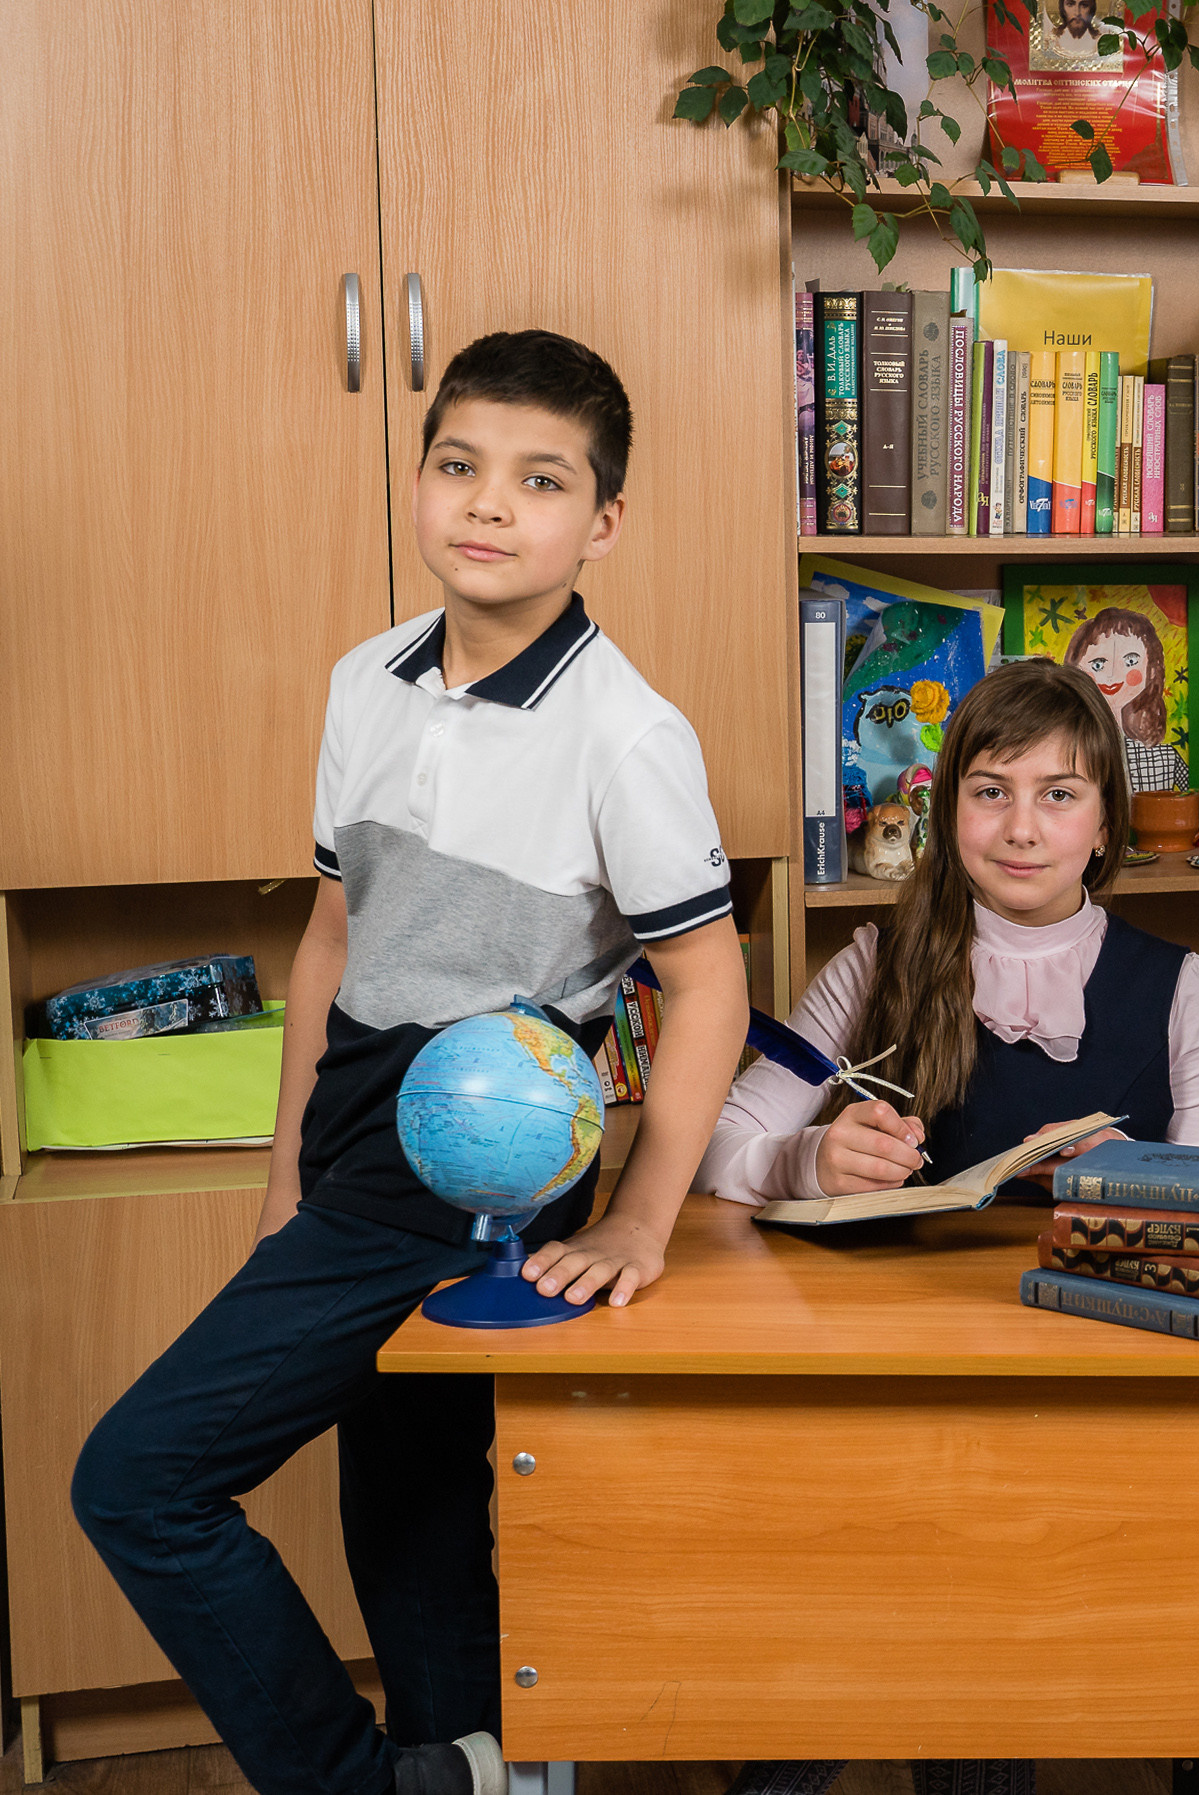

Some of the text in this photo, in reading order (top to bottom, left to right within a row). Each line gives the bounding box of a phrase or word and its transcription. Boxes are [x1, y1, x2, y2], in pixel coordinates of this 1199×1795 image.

[1044, 330, 1092, 345] Наши
[996, 350, 1005, 385] СЛОВА
[1087, 373, 1098, 406] СЛОВАРЬ
[916, 350, 929, 480] УЧЕБНЫЙ СЛОВАРЬ
[929, 355, 940, 476] РУССКОГО ЯЗЫКА
[952, 330, 965, 523] ПОСЛОВИЦЫ РУССКОГО НАРОДА
[1018, 428, 1026, 504] ОРФОГРАФИЧЕСКИЙ
[816, 822, 826, 876] ErichKrause
[98, 1018, 139, 1033] BETFORD
[1107, 1182, 1193, 1203] ПУШКИН
[1147, 1223, 1181, 1234] КУПЕР
[1144, 1263, 1157, 1273] 3
[1063, 1291, 1135, 1320] ПУШКИН
